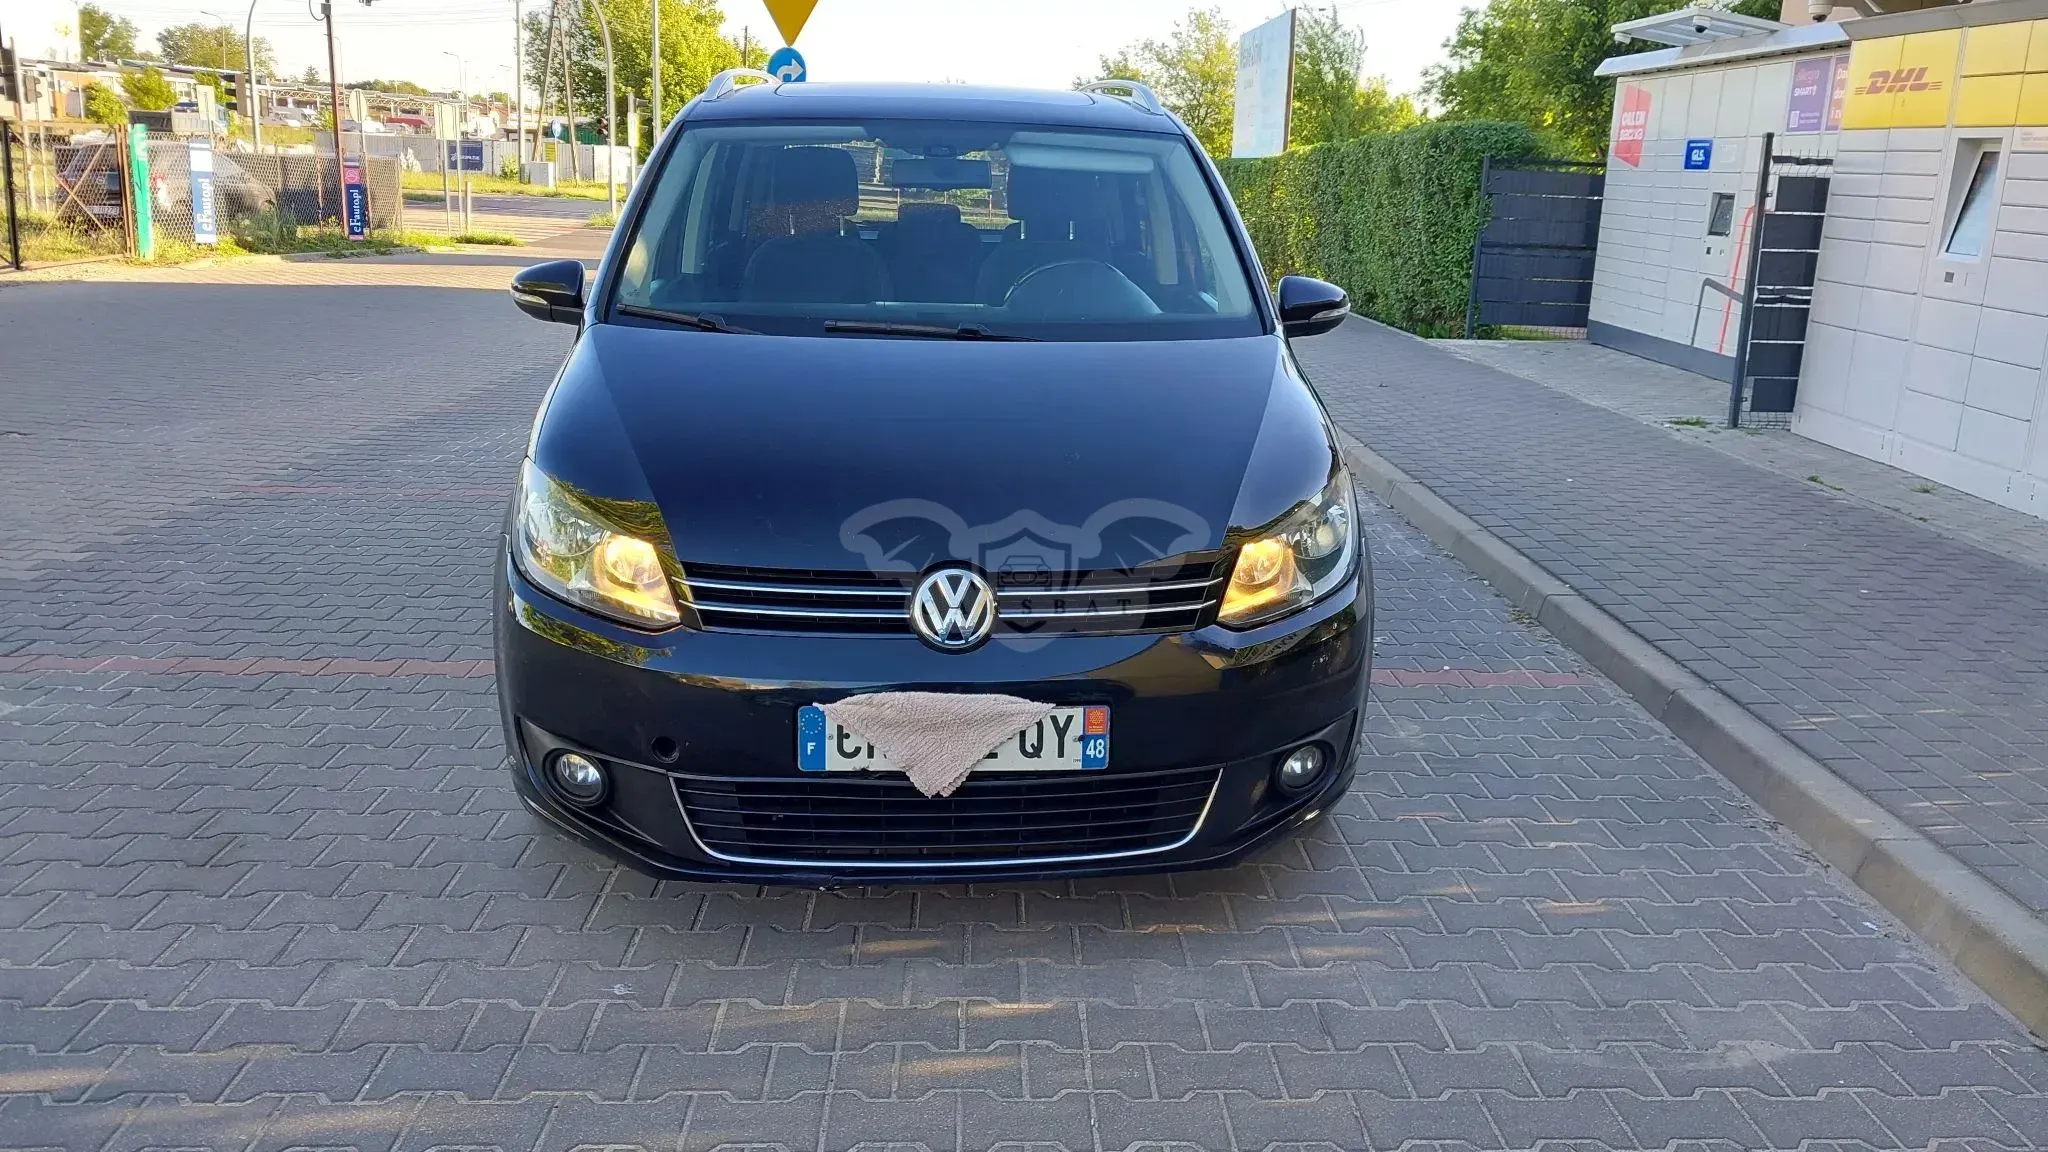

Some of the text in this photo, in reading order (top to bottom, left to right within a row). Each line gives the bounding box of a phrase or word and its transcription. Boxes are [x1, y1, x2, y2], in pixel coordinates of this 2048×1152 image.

[1866, 66, 1930, 95] DHL
[807, 742, 816, 755] F
[1085, 739, 1105, 759] 48
